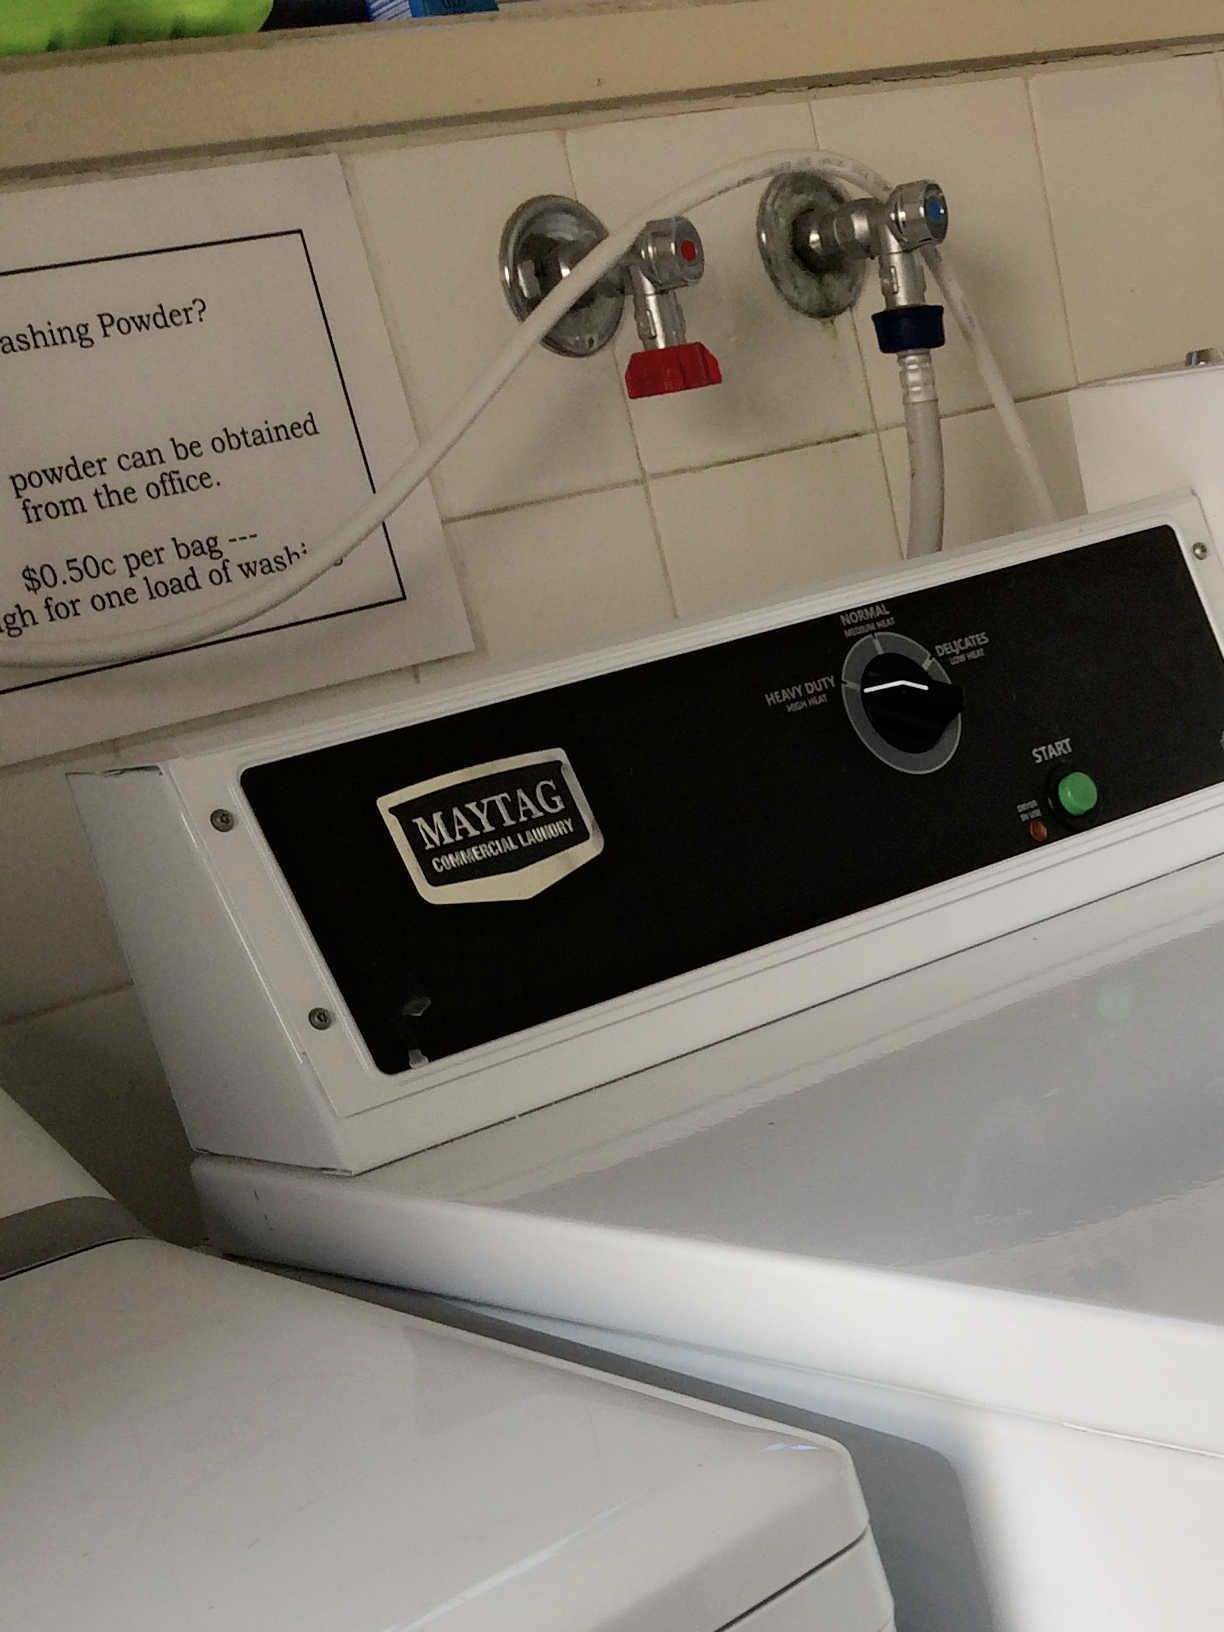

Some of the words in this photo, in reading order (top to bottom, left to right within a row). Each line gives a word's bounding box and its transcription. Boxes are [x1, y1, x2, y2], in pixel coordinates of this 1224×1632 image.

[0, 320, 95, 354] ashing
[96, 298, 207, 338] Powder?
[10, 455, 107, 498] powder
[117, 448, 165, 472] can
[170, 437, 204, 462] be
[211, 411, 320, 454] obtained
[21, 498, 88, 525] from
[94, 481, 138, 511] the
[145, 468, 222, 505] office.
[22, 554, 116, 595] $0.50c
[123, 548, 165, 578] per
[173, 535, 224, 564] bag
[0, 603, 39, 638] gh
[44, 596, 81, 622] for
[90, 578, 138, 612] one
[146, 564, 201, 605] load
[208, 558, 233, 585] of
[839, 602, 891, 627] NORMAL
[934, 631, 990, 658] DELICATES
[764, 683, 803, 707] HEAVY
[805, 674, 836, 695] DUTY
[1031, 737, 1074, 764] START
[412, 779, 566, 850] MAYTAG
[431, 836, 519, 873] COMMERCIAL
[520, 817, 576, 848] LAUNDRY
